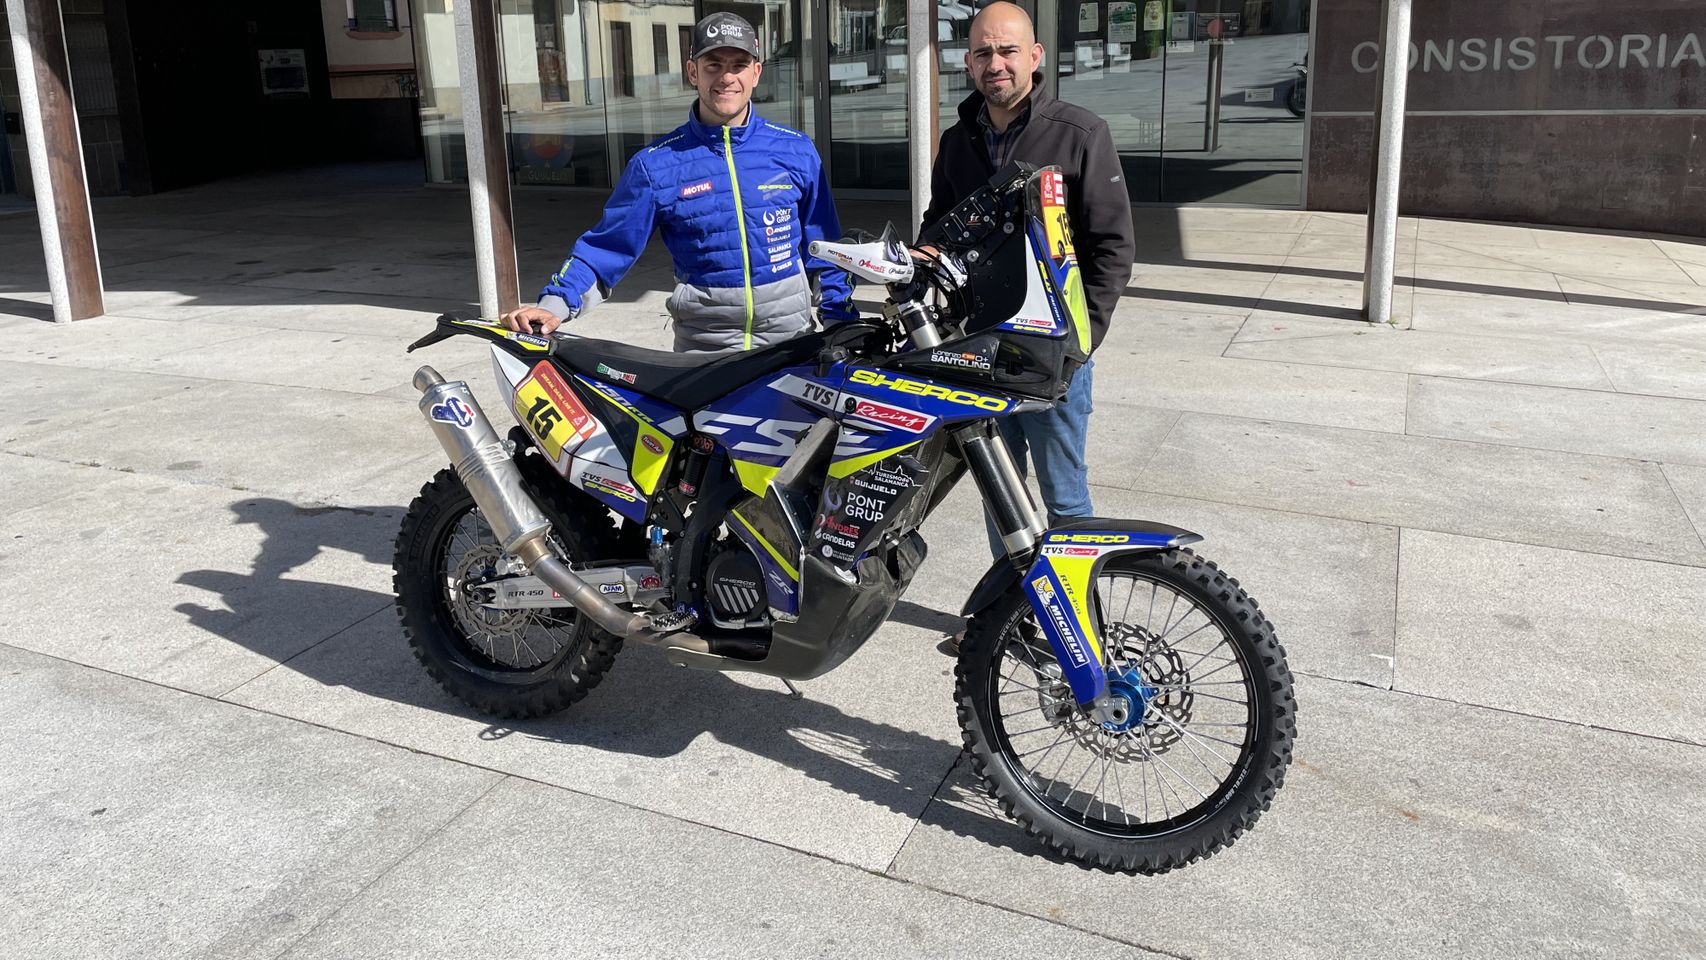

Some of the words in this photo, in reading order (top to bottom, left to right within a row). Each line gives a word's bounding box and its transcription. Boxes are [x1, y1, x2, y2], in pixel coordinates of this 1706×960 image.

[720, 24, 742, 32] PONT
[721, 30, 743, 38] GRUP
[683, 183, 712, 197] MOTUL
[775, 208, 792, 217] PONT
[776, 214, 791, 224] GRUP
[519, 334, 547, 347] MICHELIN
[932, 348, 962, 359] Lorenzo
[931, 354, 991, 370] SANTOLINO
[803, 383, 834, 406] TVS
[849, 369, 1008, 412] SHERCO
[526, 396, 563, 440] 15
[856, 402, 926, 428] Racing
[582, 471, 601, 482] TVS
[874, 475, 909, 488] SALAMANCA
[584, 481, 636, 503] SHERCO
[854, 479, 897, 496] GUIJUELO
[847, 492, 886, 512] PONT
[845, 504, 884, 523] GRUP
[822, 532, 856, 549] CANDELAS
[1049, 534, 1130, 543] SHERCO
[603, 584, 623, 593] AFAM
[719, 577, 757, 586] SHERCO
[768, 570, 795, 596] ZR
[1060, 574, 1074, 595] RTR
[1072, 597, 1082, 615] 450
[1050, 604, 1086, 663] MICHELIN
